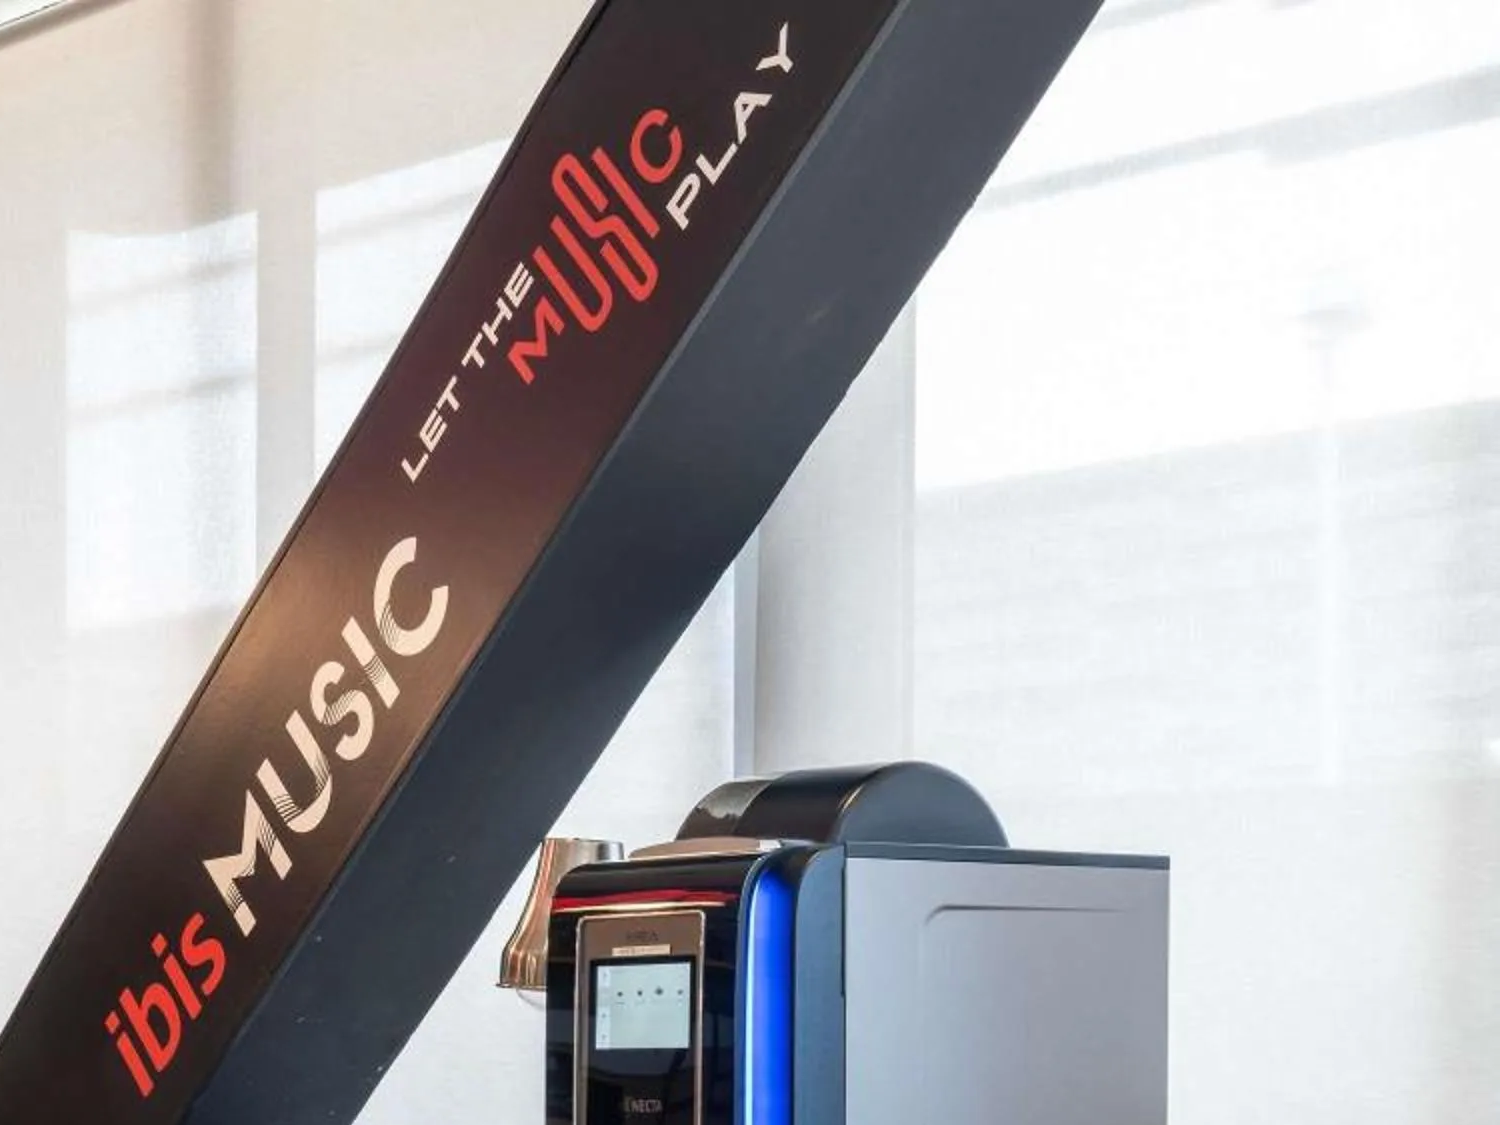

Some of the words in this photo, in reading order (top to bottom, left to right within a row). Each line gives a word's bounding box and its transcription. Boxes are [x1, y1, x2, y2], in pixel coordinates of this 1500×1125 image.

[401, 376, 457, 482] LET
[461, 262, 534, 372] THE
[507, 108, 682, 385] MUSIC
[665, 23, 793, 231] PLAY
[104, 912, 227, 1097] ibis
[203, 536, 449, 938] MUSIC
